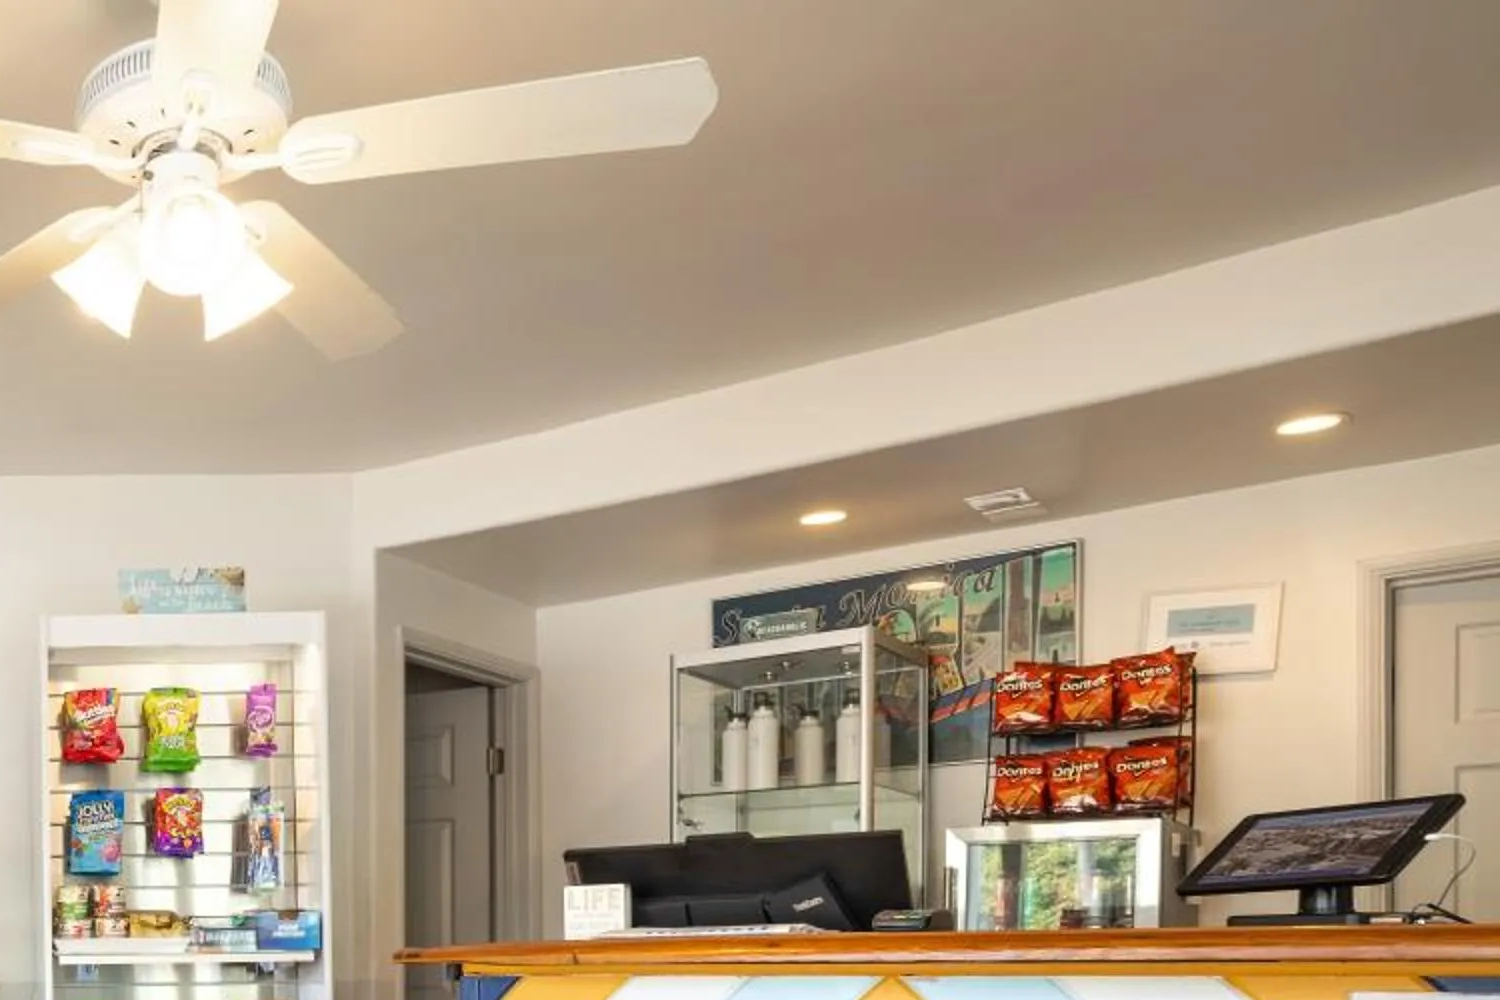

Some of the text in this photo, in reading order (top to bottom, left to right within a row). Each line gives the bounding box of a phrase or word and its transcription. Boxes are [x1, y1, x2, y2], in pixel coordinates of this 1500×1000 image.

[1120, 664, 1173, 681] Doritos
[996, 678, 1044, 694] Doritos
[1059, 676, 1109, 692] Doritos
[996, 765, 1043, 778] Doritos
[1115, 756, 1168, 774] Doritos
